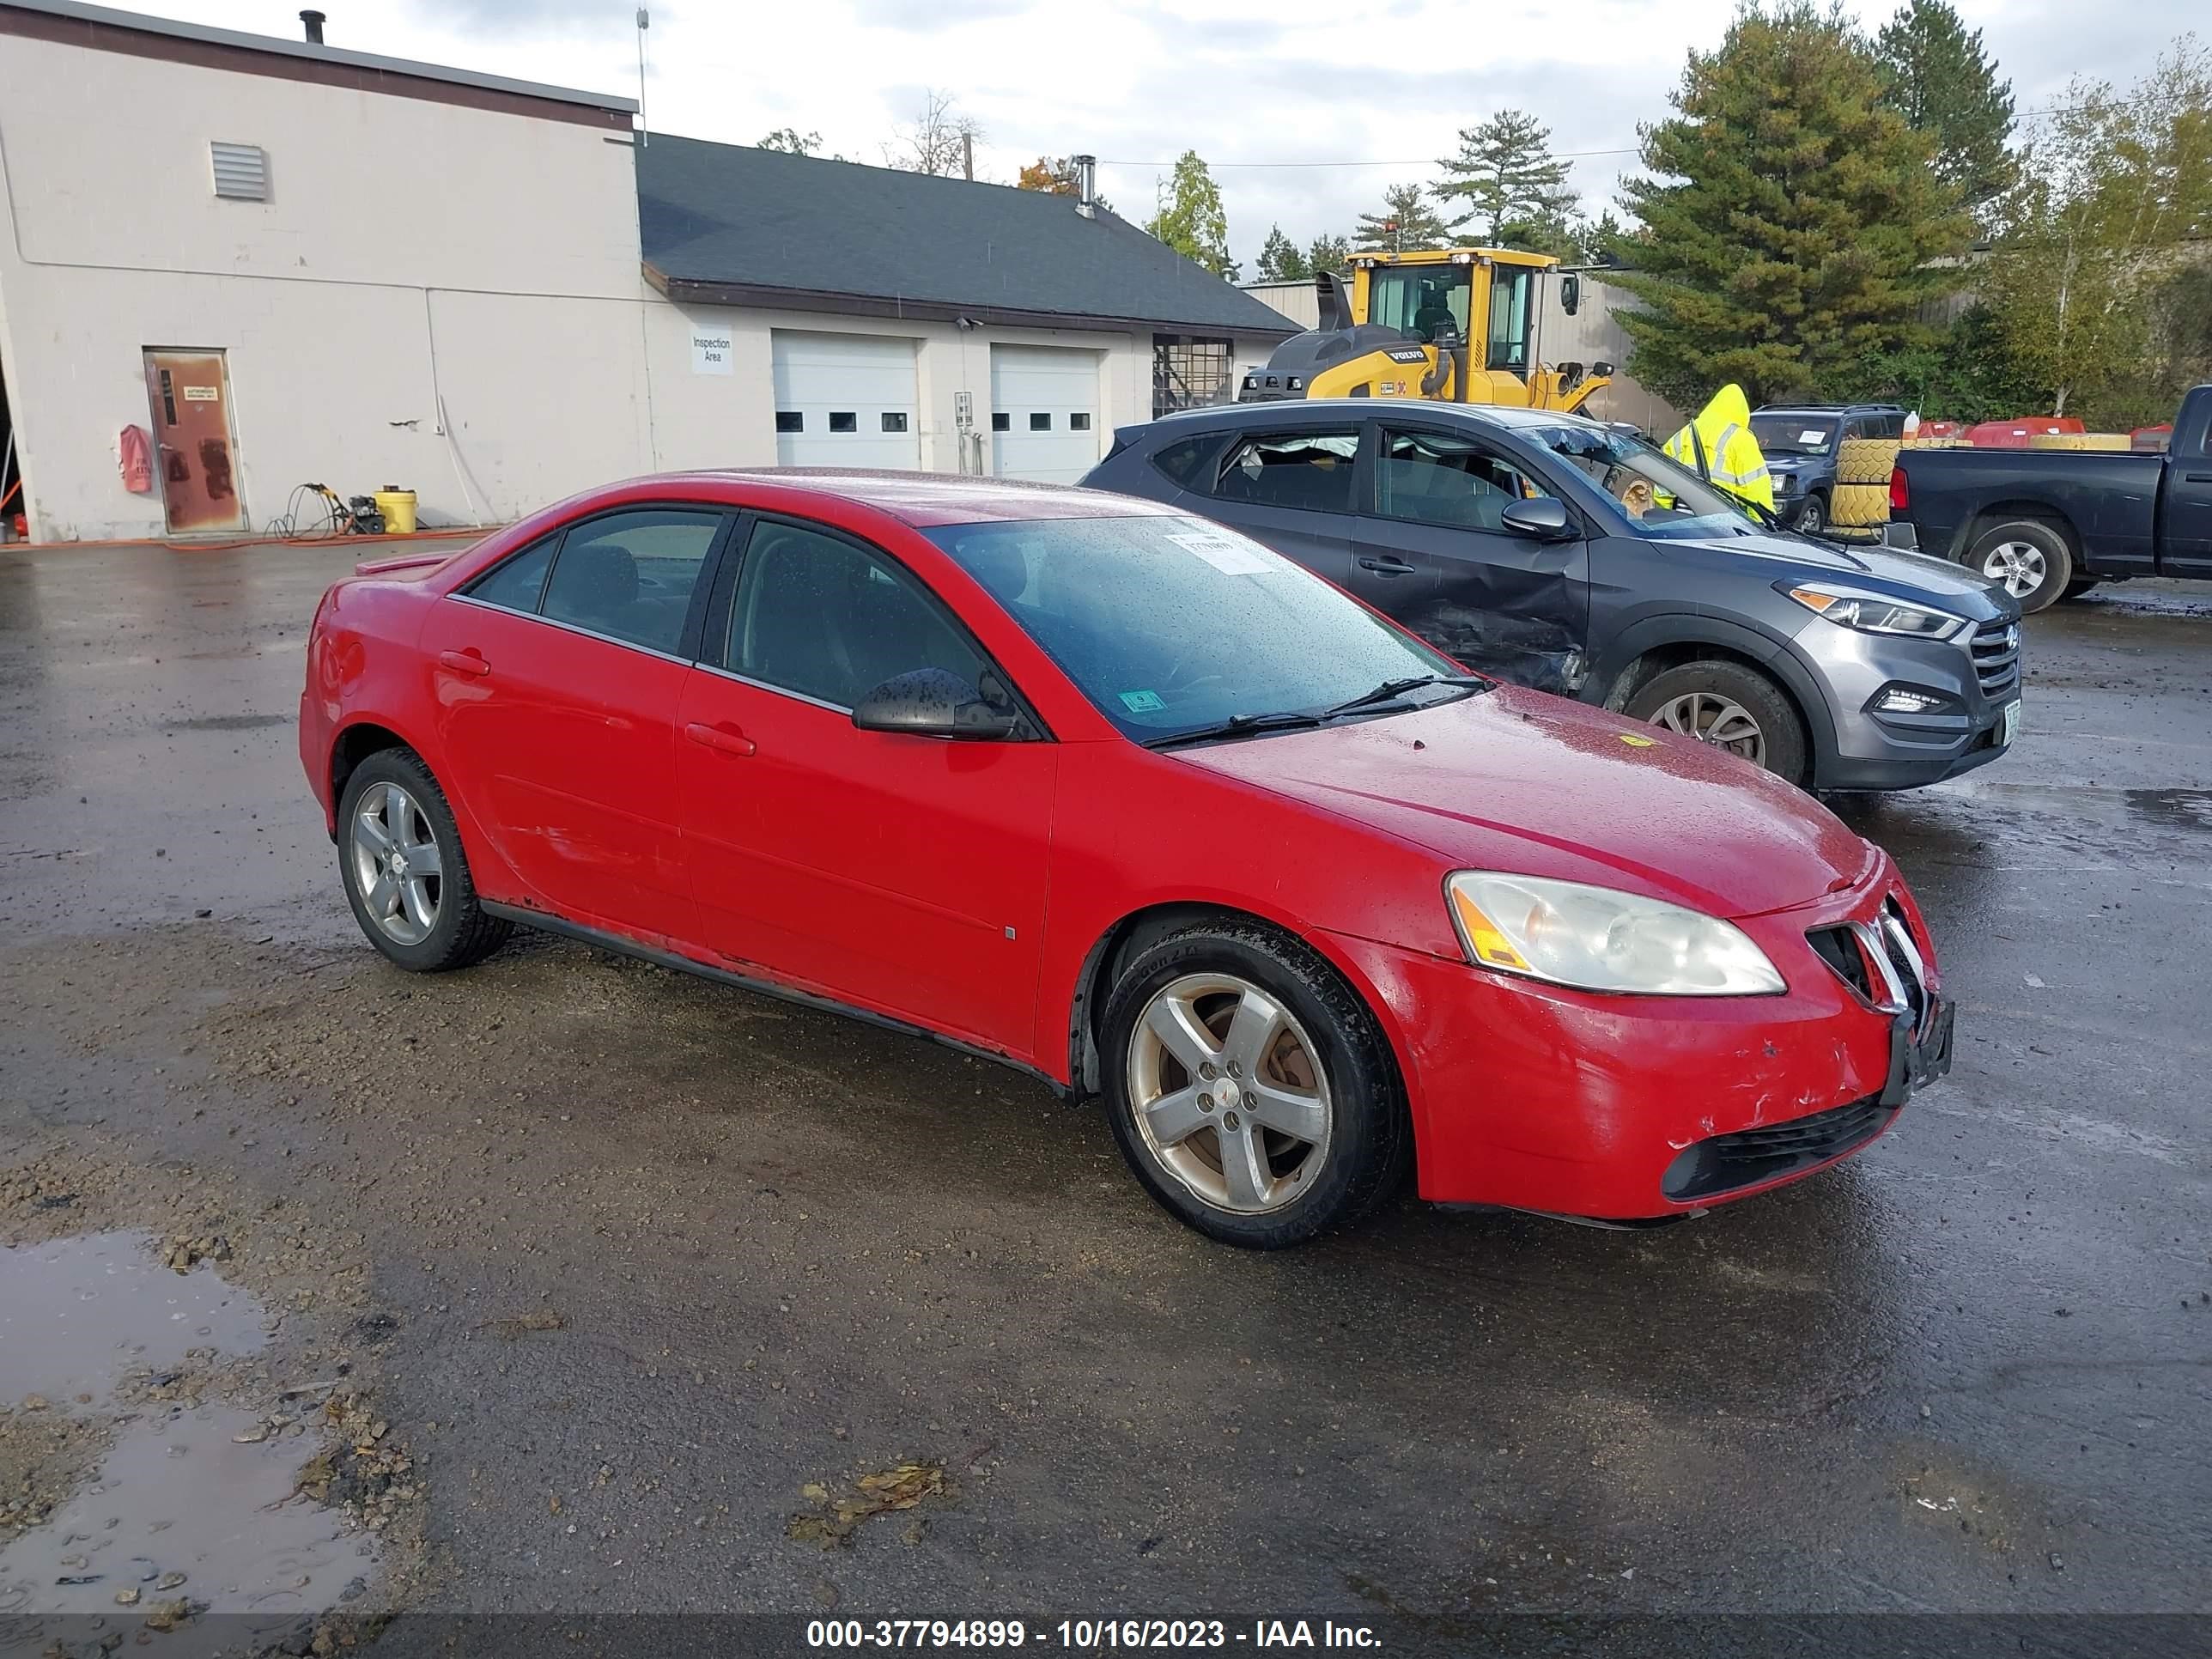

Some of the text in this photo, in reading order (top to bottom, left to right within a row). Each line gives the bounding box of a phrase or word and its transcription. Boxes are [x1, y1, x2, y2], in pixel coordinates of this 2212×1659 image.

[693, 337, 730, 349] Inspection
[705, 350, 721, 362] Area
[1389, 350, 1424, 360] VOLVO
